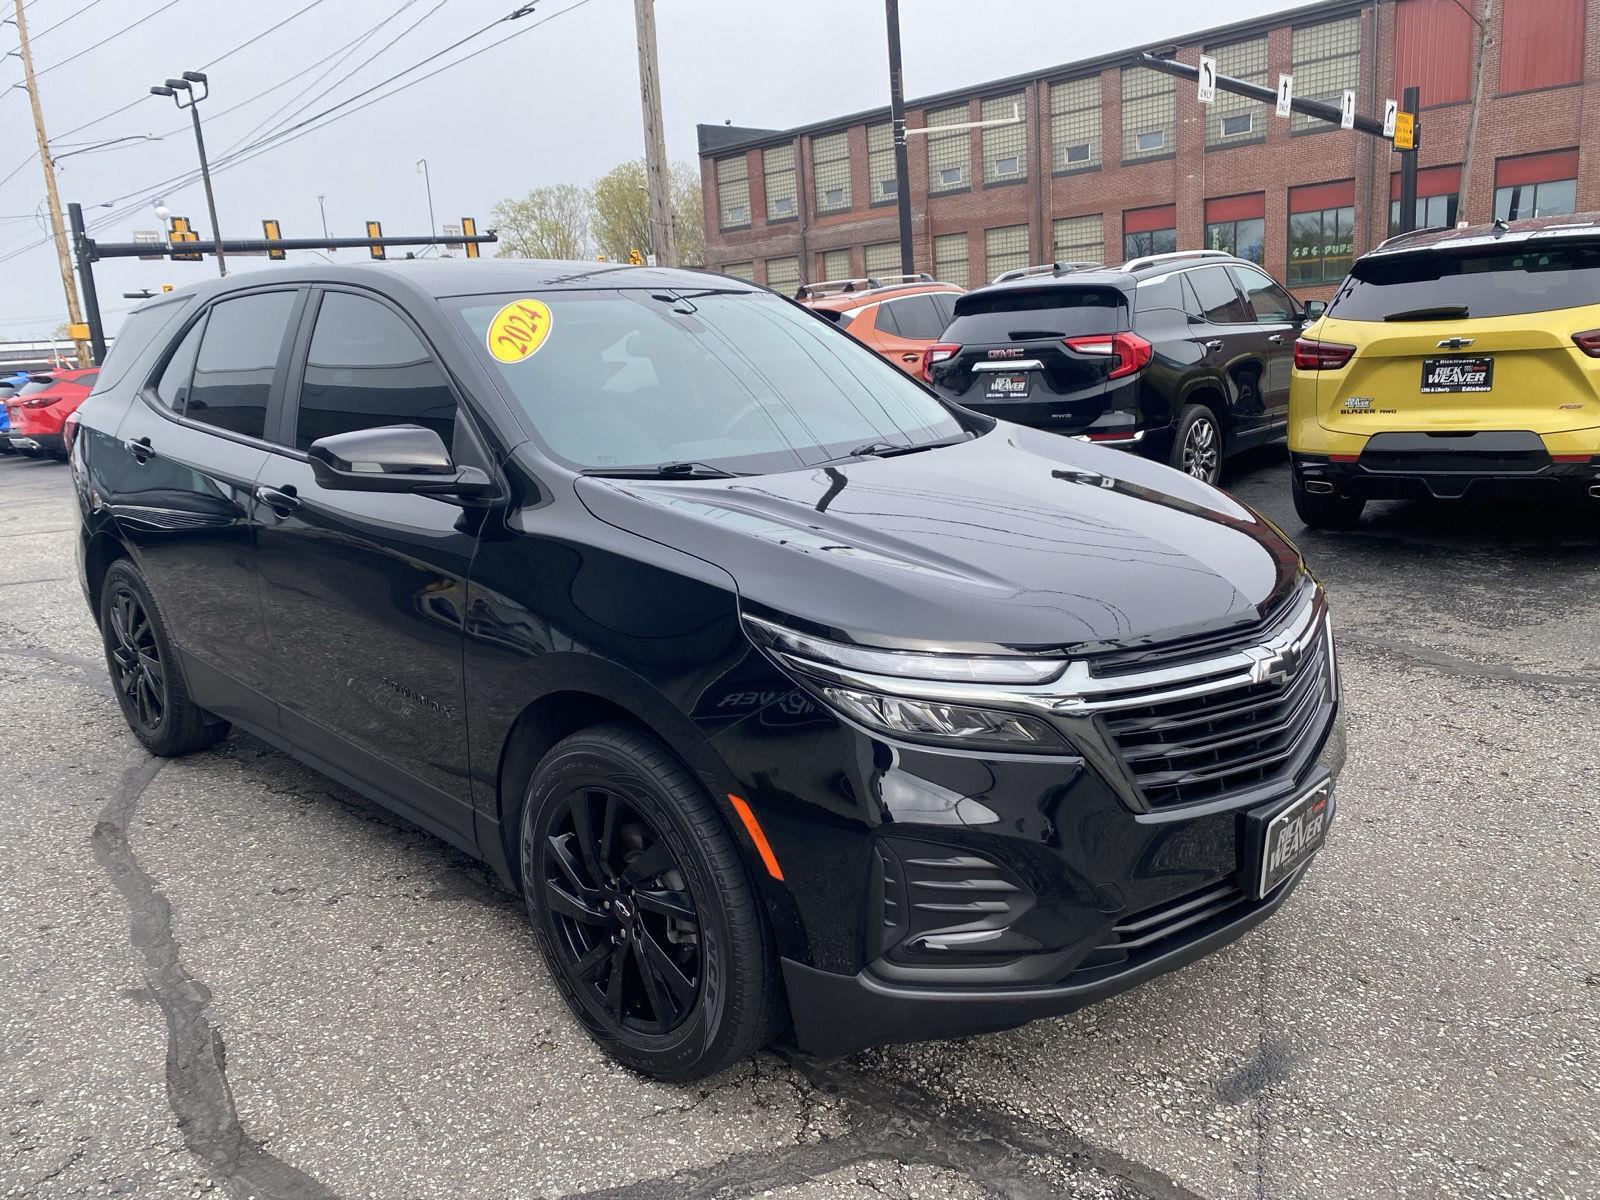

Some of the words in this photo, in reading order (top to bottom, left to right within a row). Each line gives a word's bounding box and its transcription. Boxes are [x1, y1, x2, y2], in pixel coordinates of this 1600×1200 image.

[1200, 89, 1213, 99] ONLY
[497, 304, 543, 356] 2024
[988, 348, 1024, 359] GMC
[1435, 366, 1462, 375] RICK
[1428, 372, 1486, 384] WEAVER
[991, 382, 1025, 390] WEAVER
[1277, 812, 1306, 849] RICK
[1269, 813, 1325, 873] WEAVER
